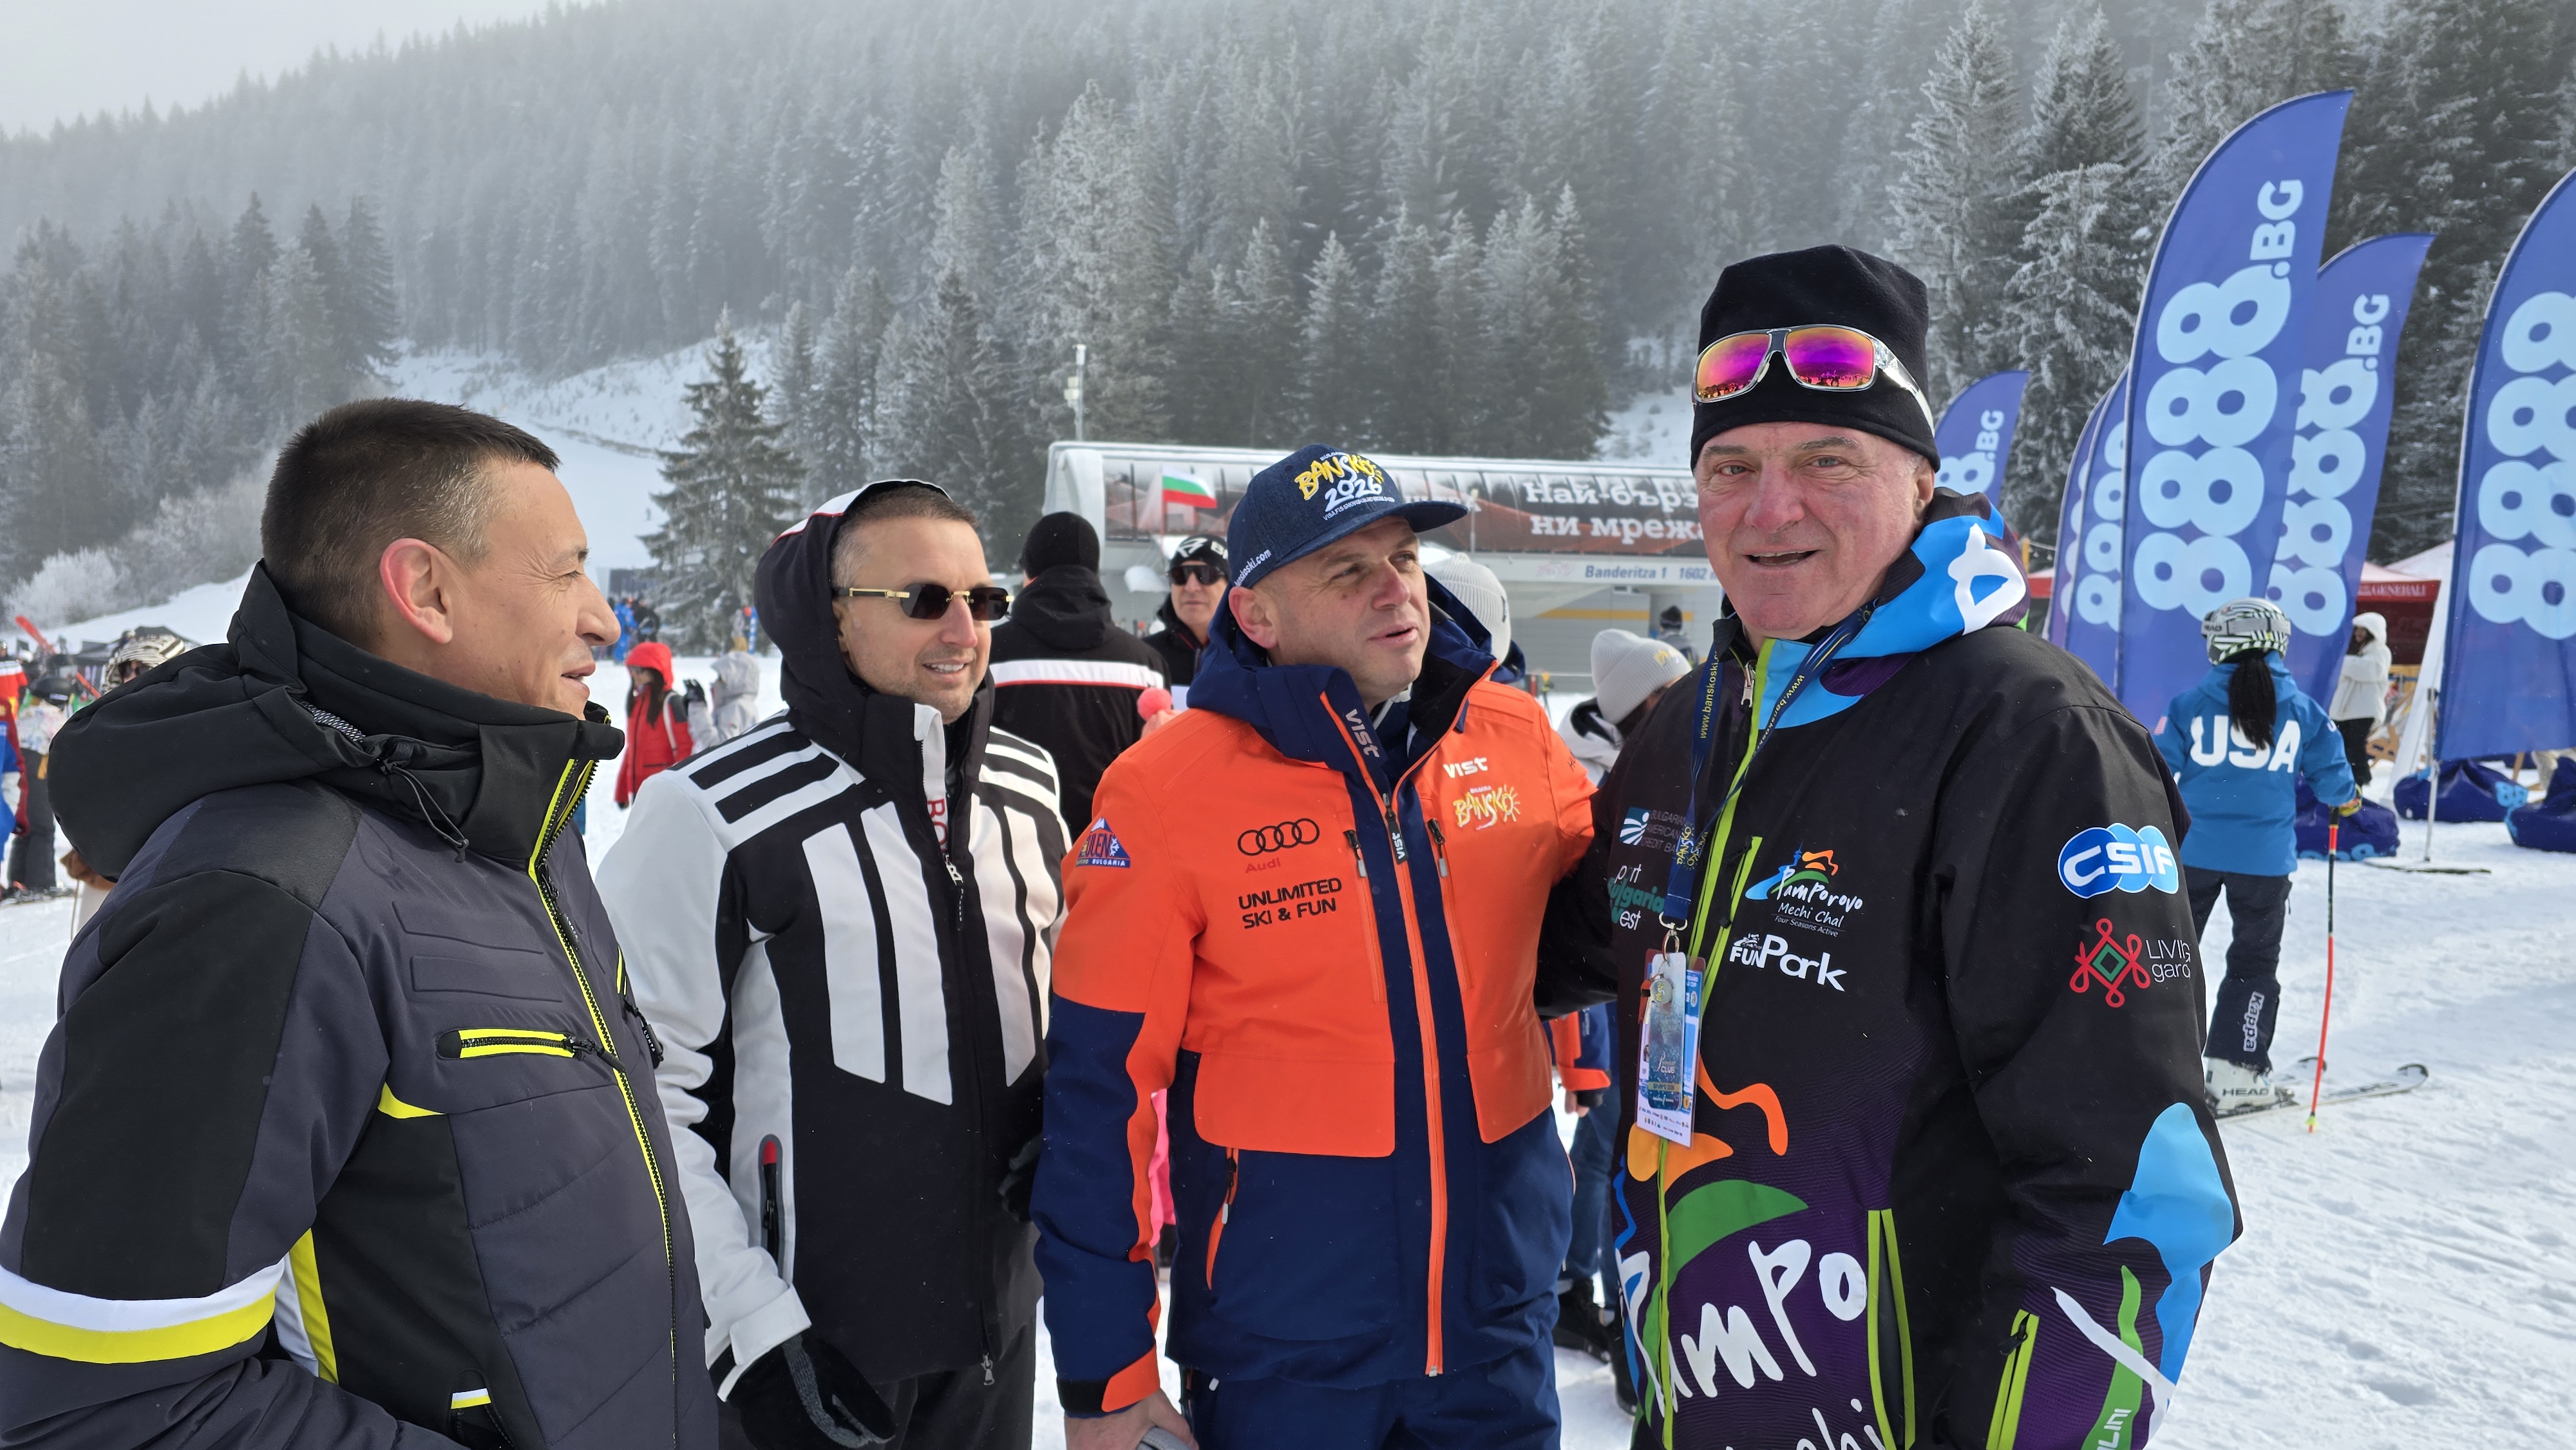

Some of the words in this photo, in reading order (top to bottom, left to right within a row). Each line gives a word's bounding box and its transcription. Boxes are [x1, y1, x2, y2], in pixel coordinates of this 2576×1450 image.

[2133, 179, 2304, 621] 8888.BG
[1294, 453, 1375, 500] BANSKO
[1325, 476, 1382, 512] 2026
[1523, 479, 1699, 513] Най-бърз
[1531, 515, 1581, 536] ни
[1585, 565, 1656, 579] Banderitza
[1680, 567, 1708, 580] 1602
[1092, 858, 1126, 867] BULGARIA
[1245, 857, 1282, 874] Audi
[1238, 877, 1342, 910] UNLIMITED
[1242, 910, 1273, 929] SKI
[1278, 907, 1292, 921] &
[1296, 898, 1336, 918] FUN
[1774, 915, 1790, 925] Four
[1790, 919, 1817, 932] Seasons
[1817, 926, 1839, 937] Active
[1777, 902, 1814, 919] Mechi
[1815, 910, 1844, 928] Chal
[1730, 946, 1763, 968] FUN
[1759, 934, 1848, 992] Park
[2242, 991, 2265, 1053] Kappa
[2222, 1086, 2269, 1097] HEAD
